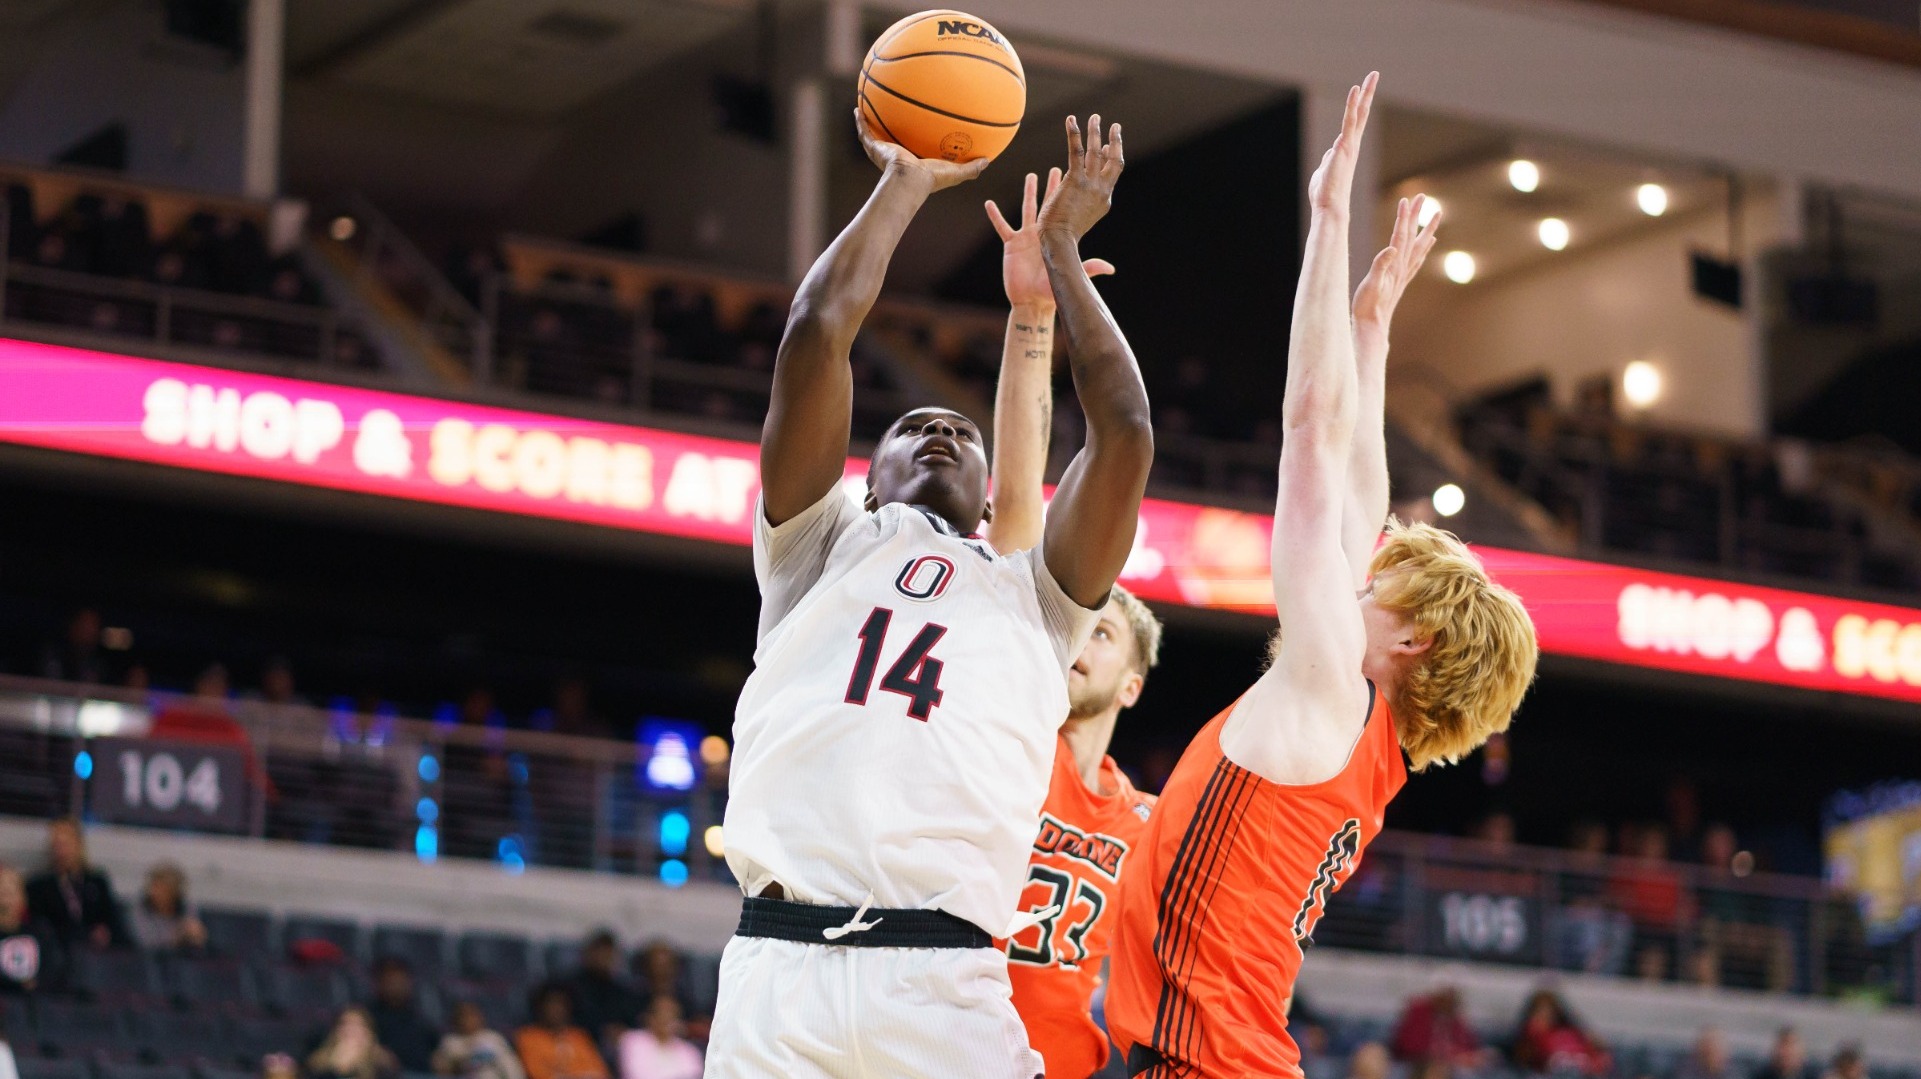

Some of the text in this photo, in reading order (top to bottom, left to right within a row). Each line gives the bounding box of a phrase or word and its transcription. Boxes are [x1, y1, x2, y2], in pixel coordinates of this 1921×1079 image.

[142, 377, 756, 524] SHOP & SCORE AT
[844, 607, 948, 722] 14
[1617, 583, 1774, 663] SHOP
[1776, 606, 1825, 671] &
[120, 751, 221, 813] 104
[1006, 863, 1106, 971] 33
